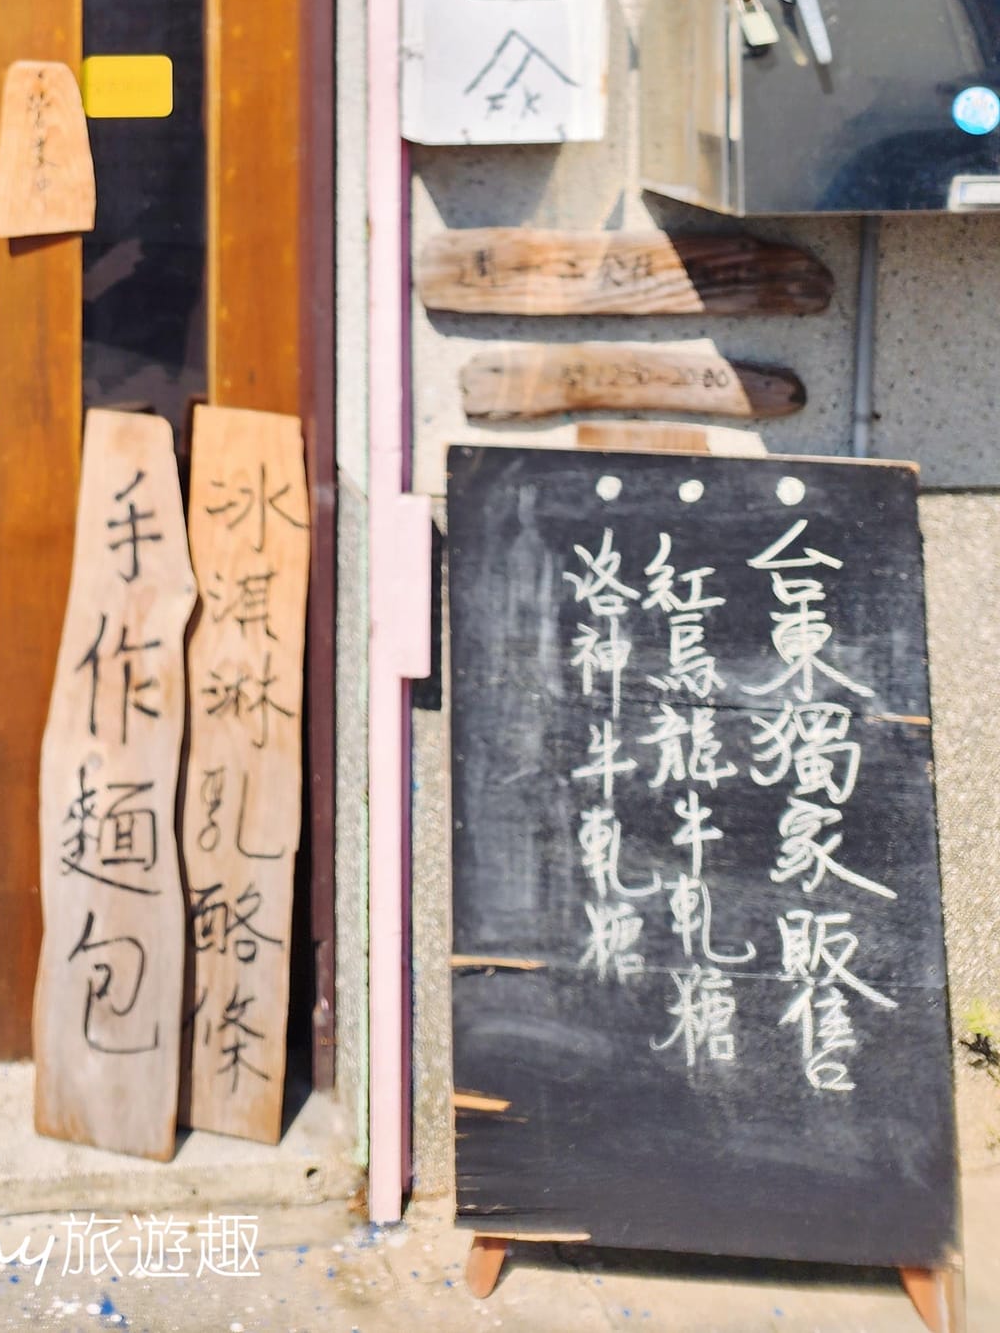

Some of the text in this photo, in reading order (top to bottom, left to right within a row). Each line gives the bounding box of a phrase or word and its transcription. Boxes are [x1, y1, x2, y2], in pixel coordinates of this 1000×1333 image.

[59, 469, 162, 1055] 手作麵包
[187, 462, 311, 1094] 冰淇淋乳酪條
[562, 527, 661, 983] 洛神牛軋糖
[740, 519, 898, 1090] 台東獨家販售
